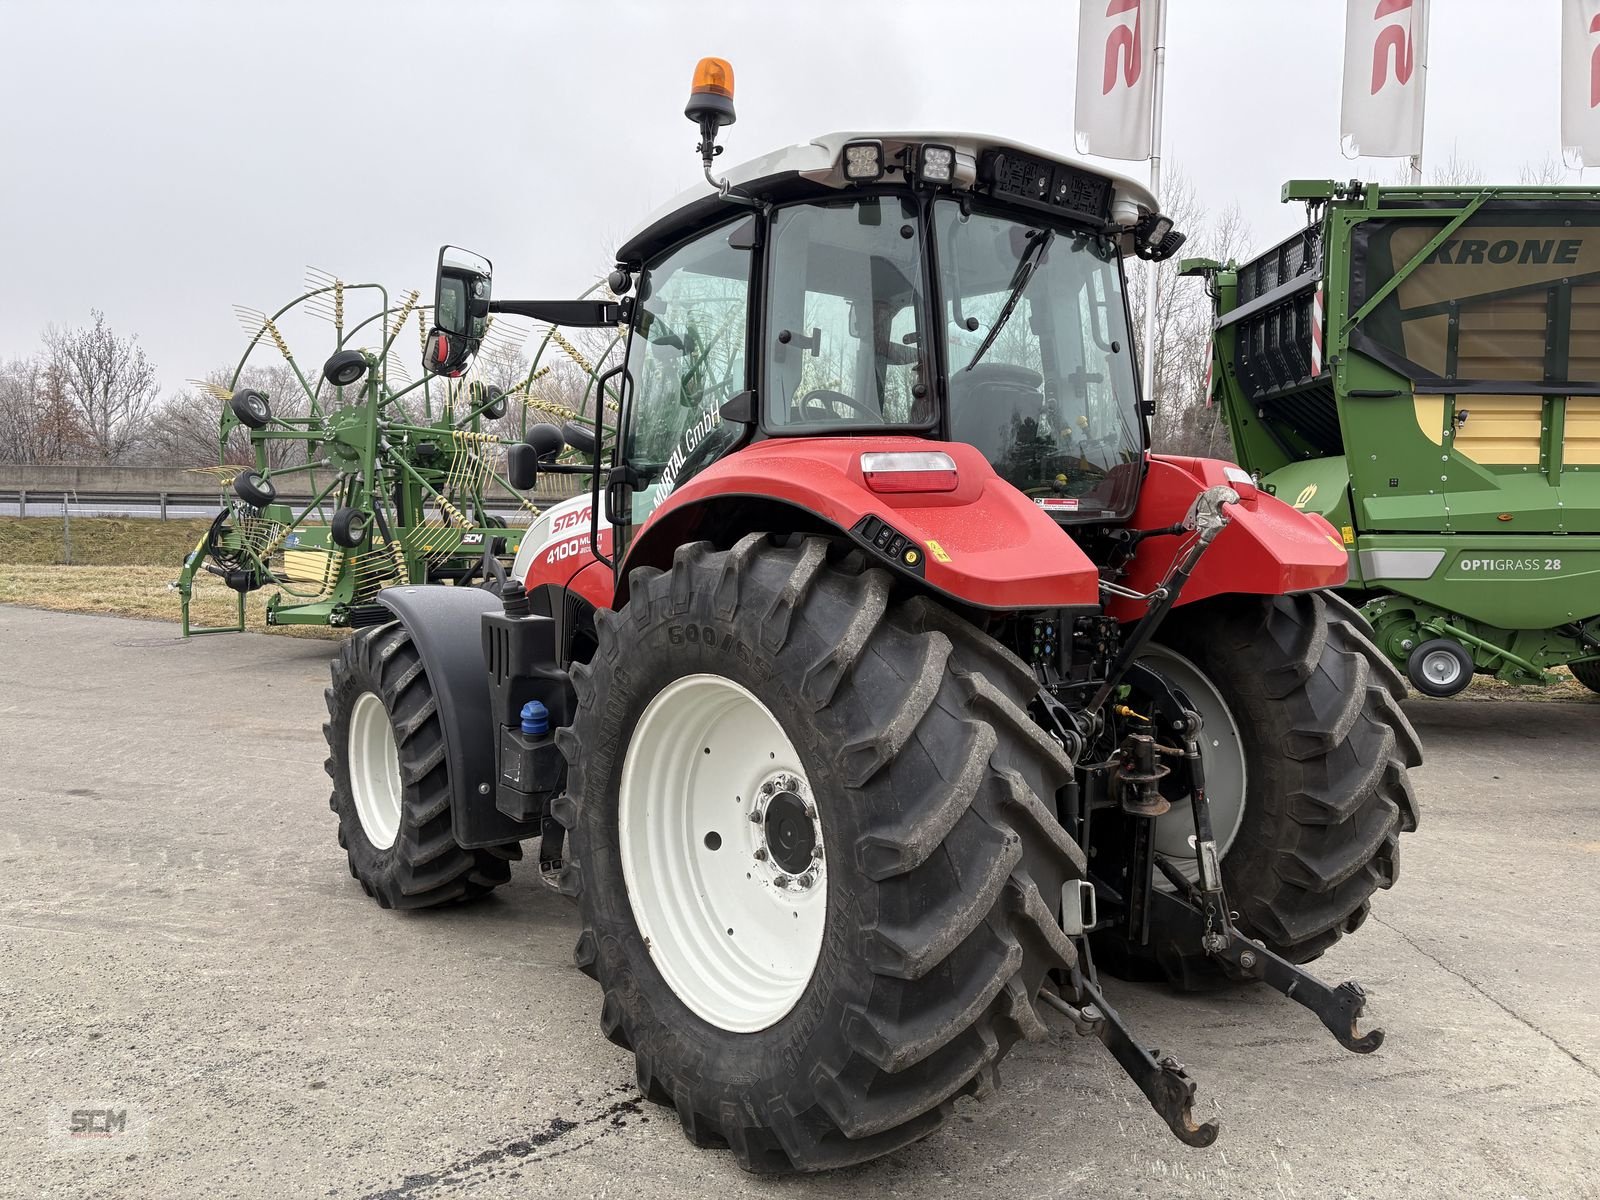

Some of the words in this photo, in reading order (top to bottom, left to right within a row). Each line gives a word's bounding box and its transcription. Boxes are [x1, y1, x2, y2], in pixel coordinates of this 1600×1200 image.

[1423, 239, 1583, 265] KRONE
[685, 399, 721, 452] GmbH
[551, 505, 593, 534] STEYR
[462, 533, 484, 543] SCM
[546, 539, 579, 564] 4100
[1460, 558, 1540, 572] OPTIGRASS
[1543, 558, 1562, 571] 28
